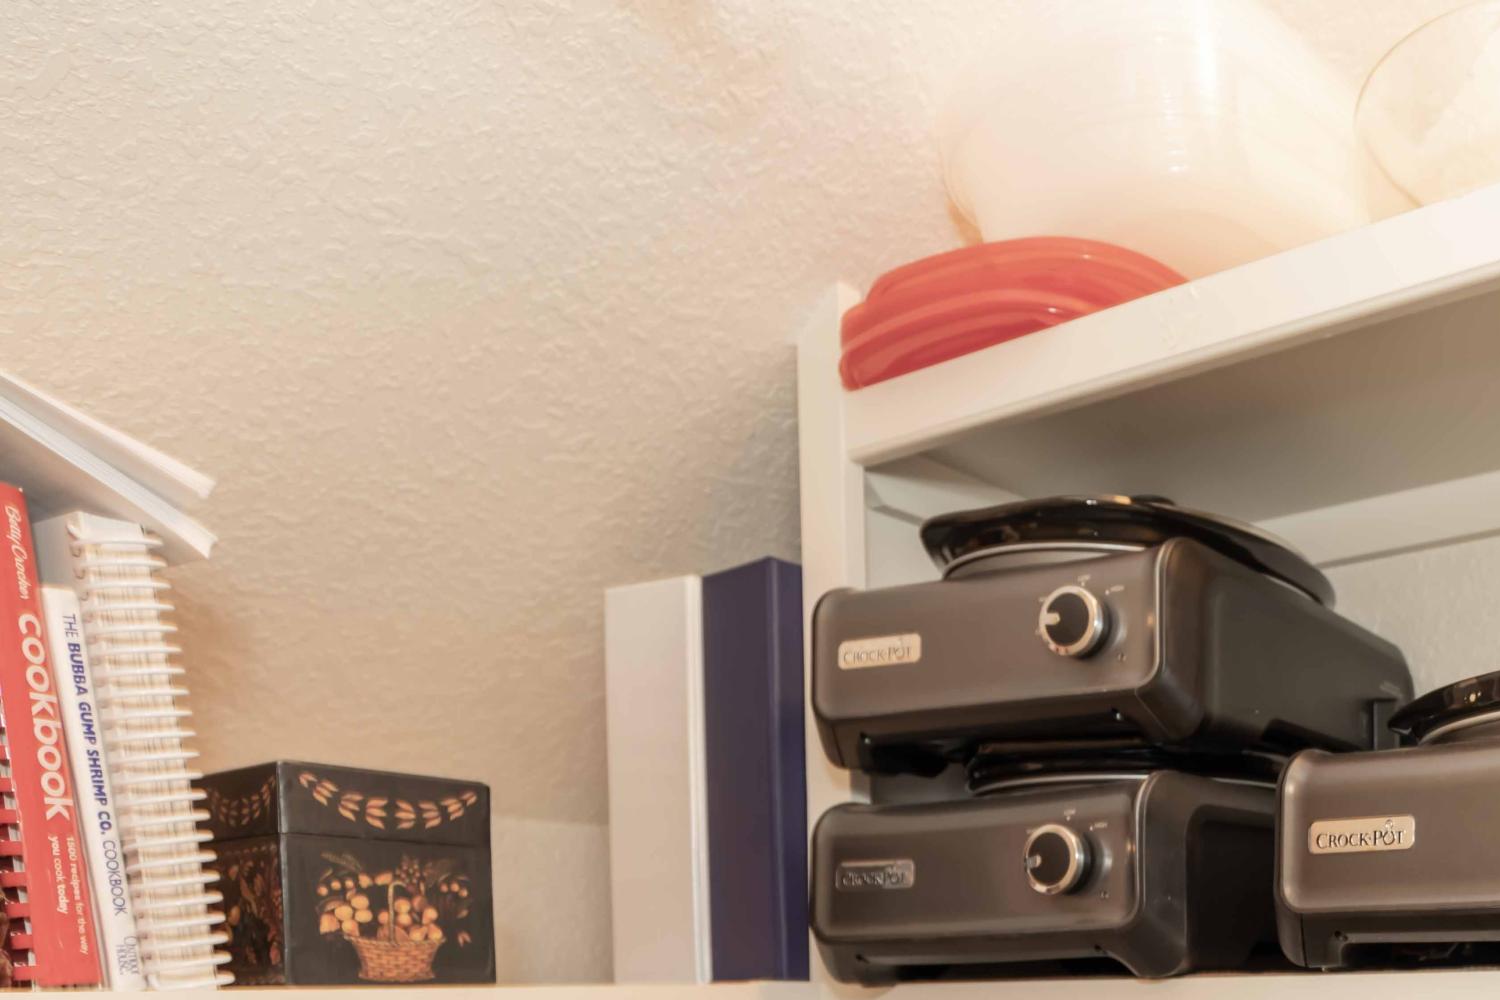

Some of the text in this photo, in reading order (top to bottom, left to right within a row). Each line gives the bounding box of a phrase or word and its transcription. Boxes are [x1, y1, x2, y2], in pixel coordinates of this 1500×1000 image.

[63, 614, 127, 916] THE BUBBA GUMP SHRIMP CO. COOKBOOK
[48, 836, 68, 914] you cook today
